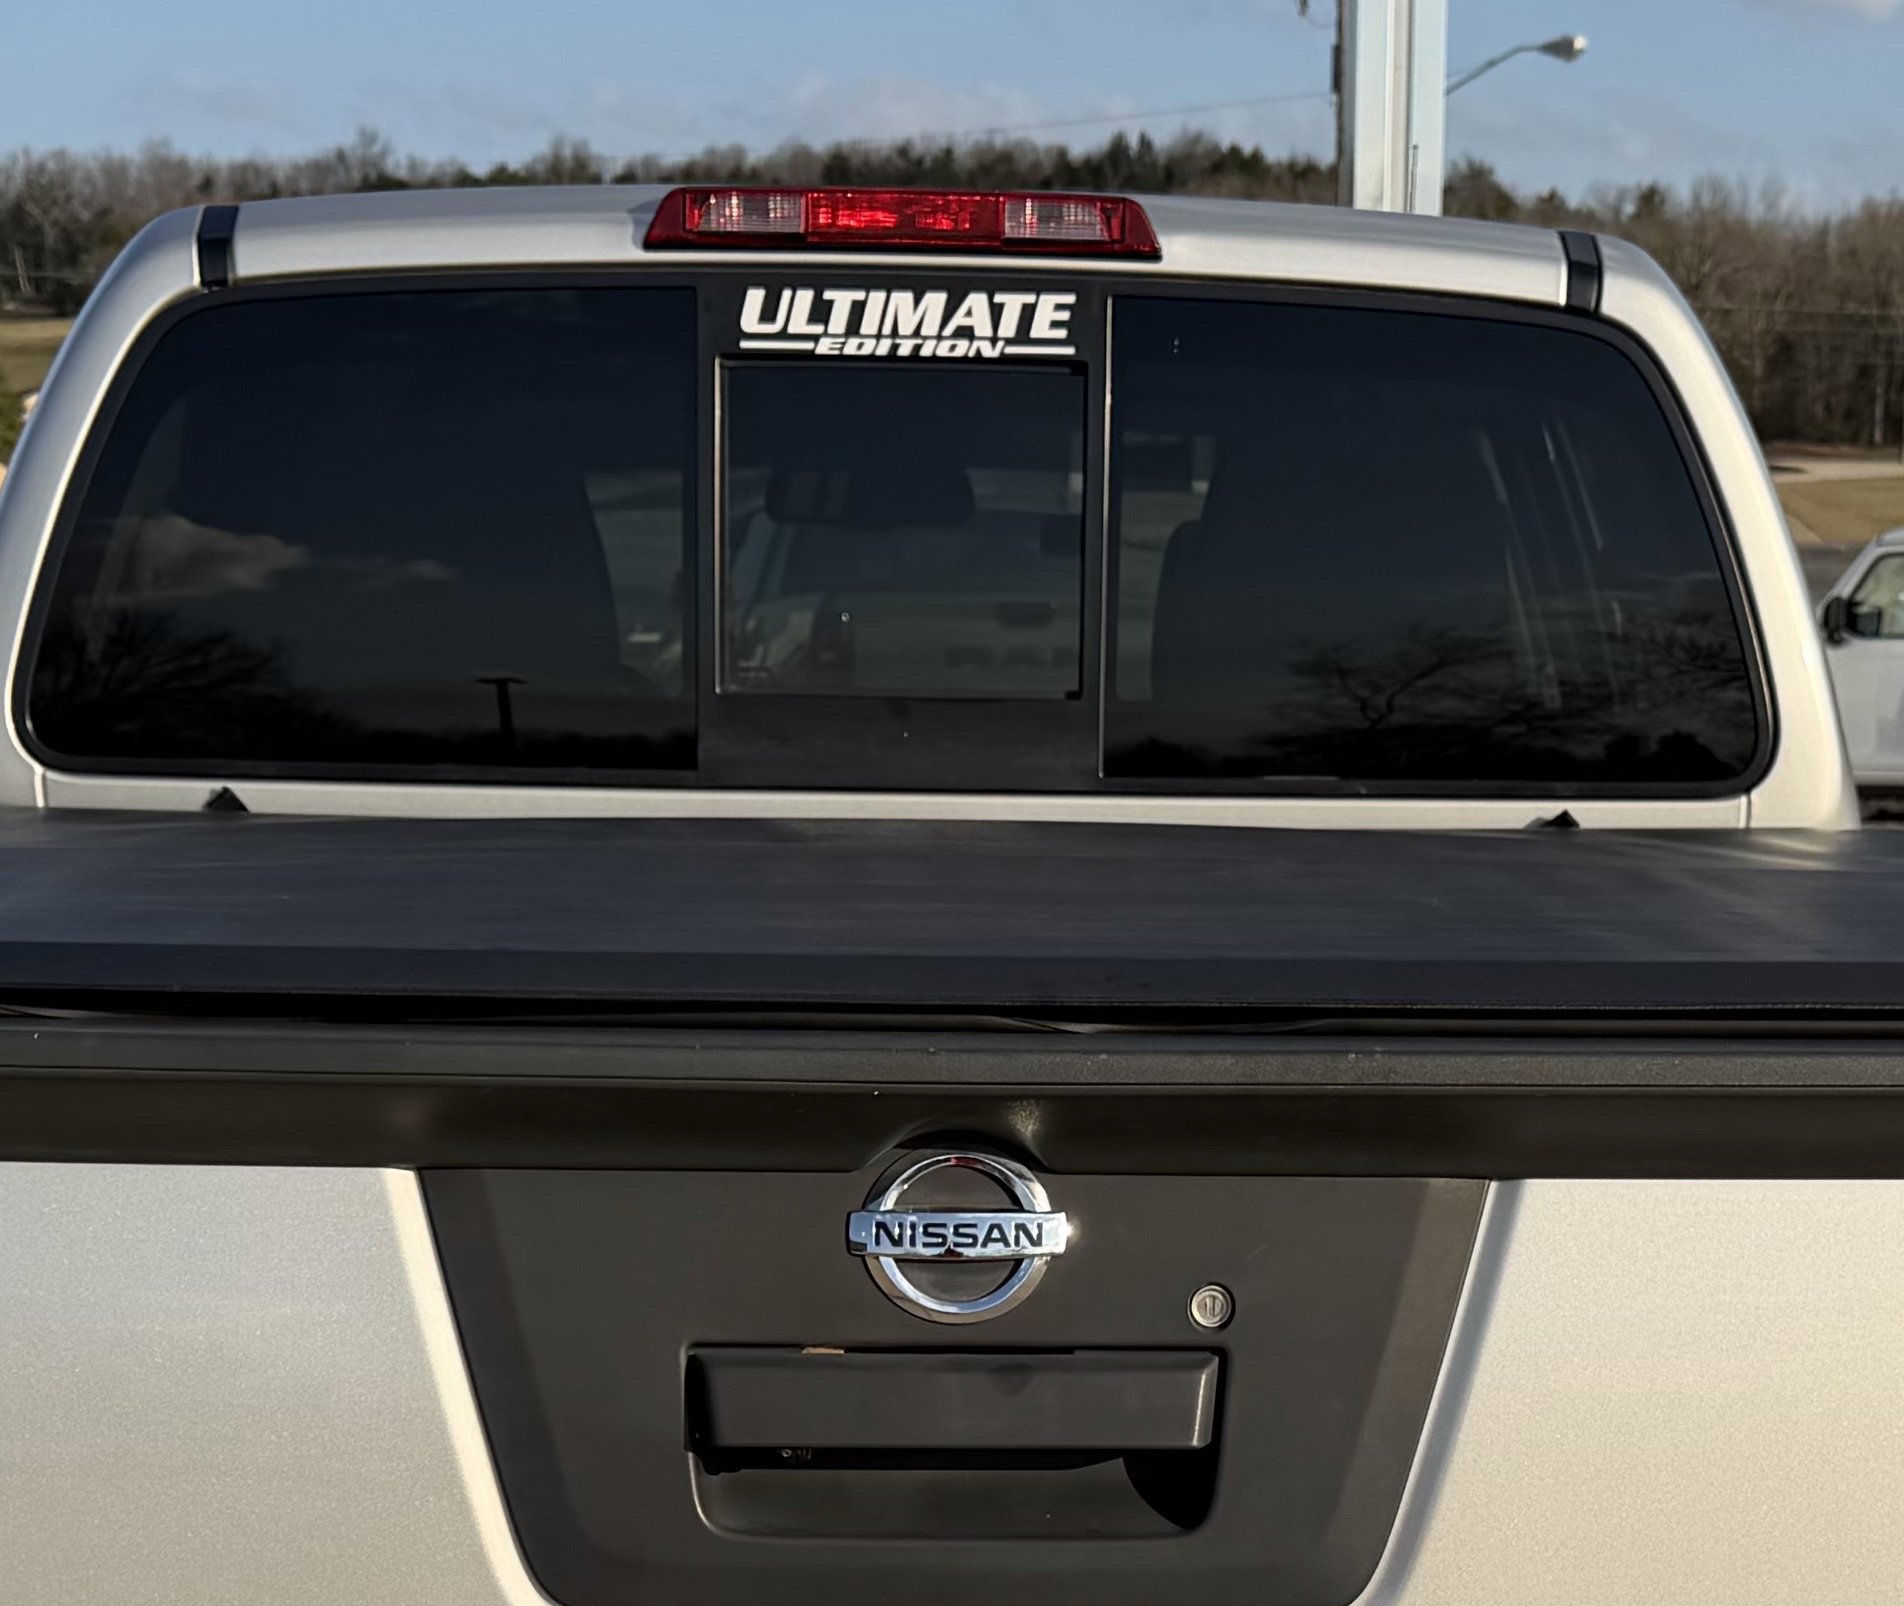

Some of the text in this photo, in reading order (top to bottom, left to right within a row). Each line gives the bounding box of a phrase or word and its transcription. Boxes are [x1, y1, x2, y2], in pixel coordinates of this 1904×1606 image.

[740, 287, 1077, 339] ULTIMATE
[814, 336, 1005, 358] EDITION
[874, 1221, 1043, 1248] NISSAN
